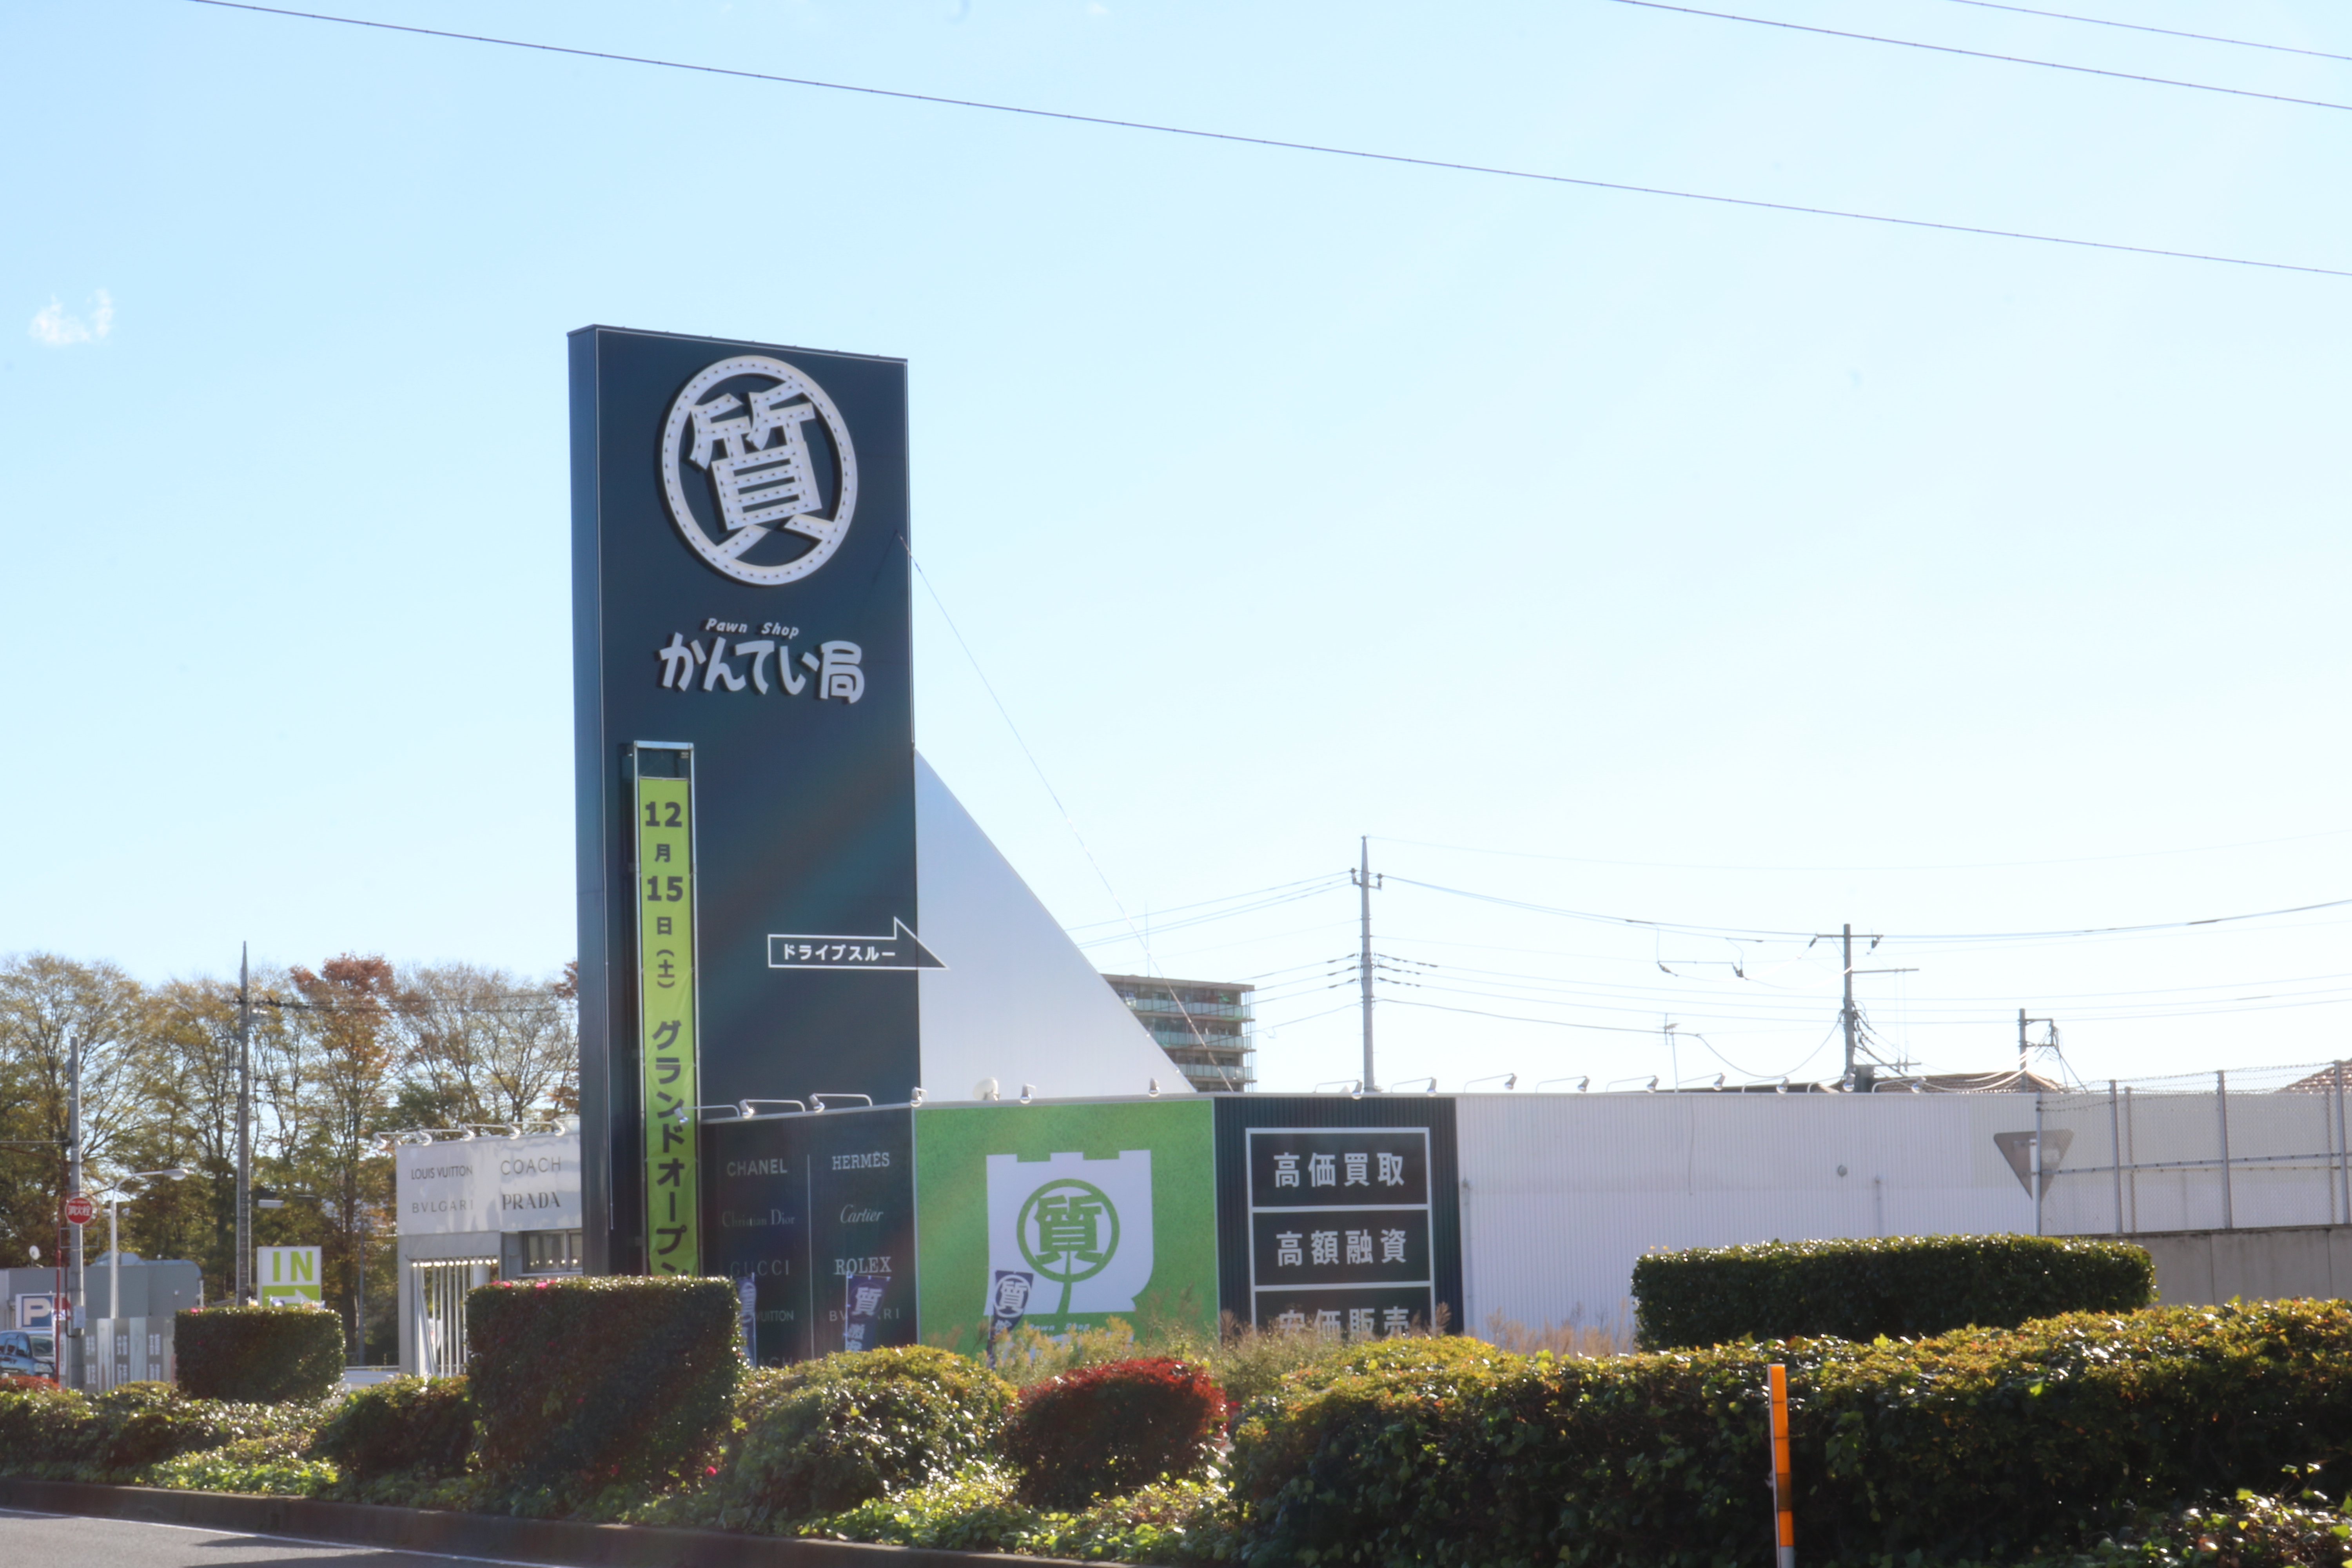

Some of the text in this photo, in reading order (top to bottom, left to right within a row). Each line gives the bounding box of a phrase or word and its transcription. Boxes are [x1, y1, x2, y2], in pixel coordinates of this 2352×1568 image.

[686, 378, 838, 561] 質
[706, 618, 799, 640] Pawn Shop
[659, 632, 865, 704] かんてい局
[784, 944, 896, 961] ドライブスルー
[412, 1165, 473, 1180] LOUIS VUITTON
[501, 1156, 561, 1175] COACH
[727, 1158, 788, 1176] CHANEL
[1273, 1152, 1405, 1188] 高価買取
[412, 1199, 474, 1213] BVLGARI
[502, 1192, 561, 1210] PRADA
[771, 1209, 795, 1225] Dior
[840, 1204, 884, 1223] Cartier
[1030, 1192, 1106, 1267] 質
[1276, 1229, 1407, 1267] 高額融資
[273, 1251, 313, 1282] IN
[730, 1259, 789, 1276] GUCCI
[833, 1256, 892, 1275] ROLEX
[851, 1286, 882, 1316] 質
[998, 1279, 1029, 1314] 質
[23, 1297, 51, 1326] P
